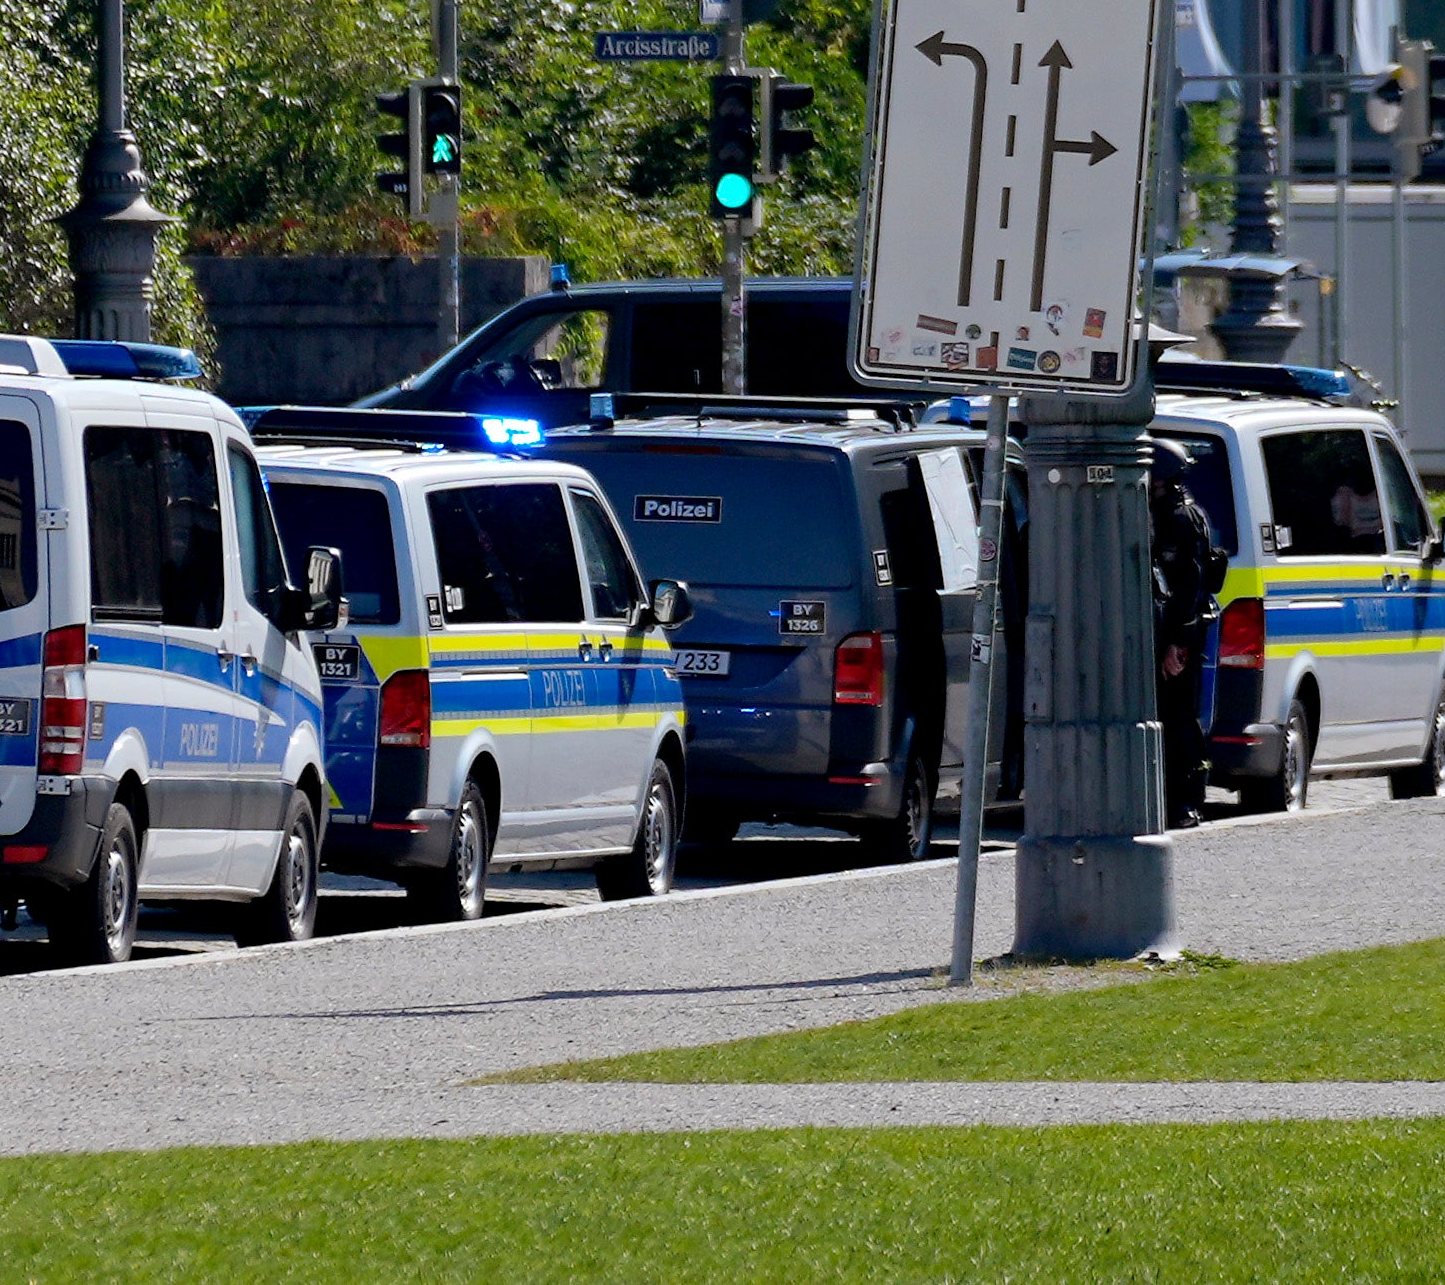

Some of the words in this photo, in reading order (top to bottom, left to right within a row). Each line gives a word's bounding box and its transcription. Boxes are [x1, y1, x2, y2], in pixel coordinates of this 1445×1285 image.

[602, 35, 710, 60] Arcisstraße
[644, 500, 713, 518] Polizei
[792, 604, 813, 616] BY
[787, 620, 818, 631] 1326
[325, 648, 347, 661] BY
[683, 652, 720, 671] 233
[320, 662, 352, 676] 1321
[542, 670, 585, 707] POLIZEI
